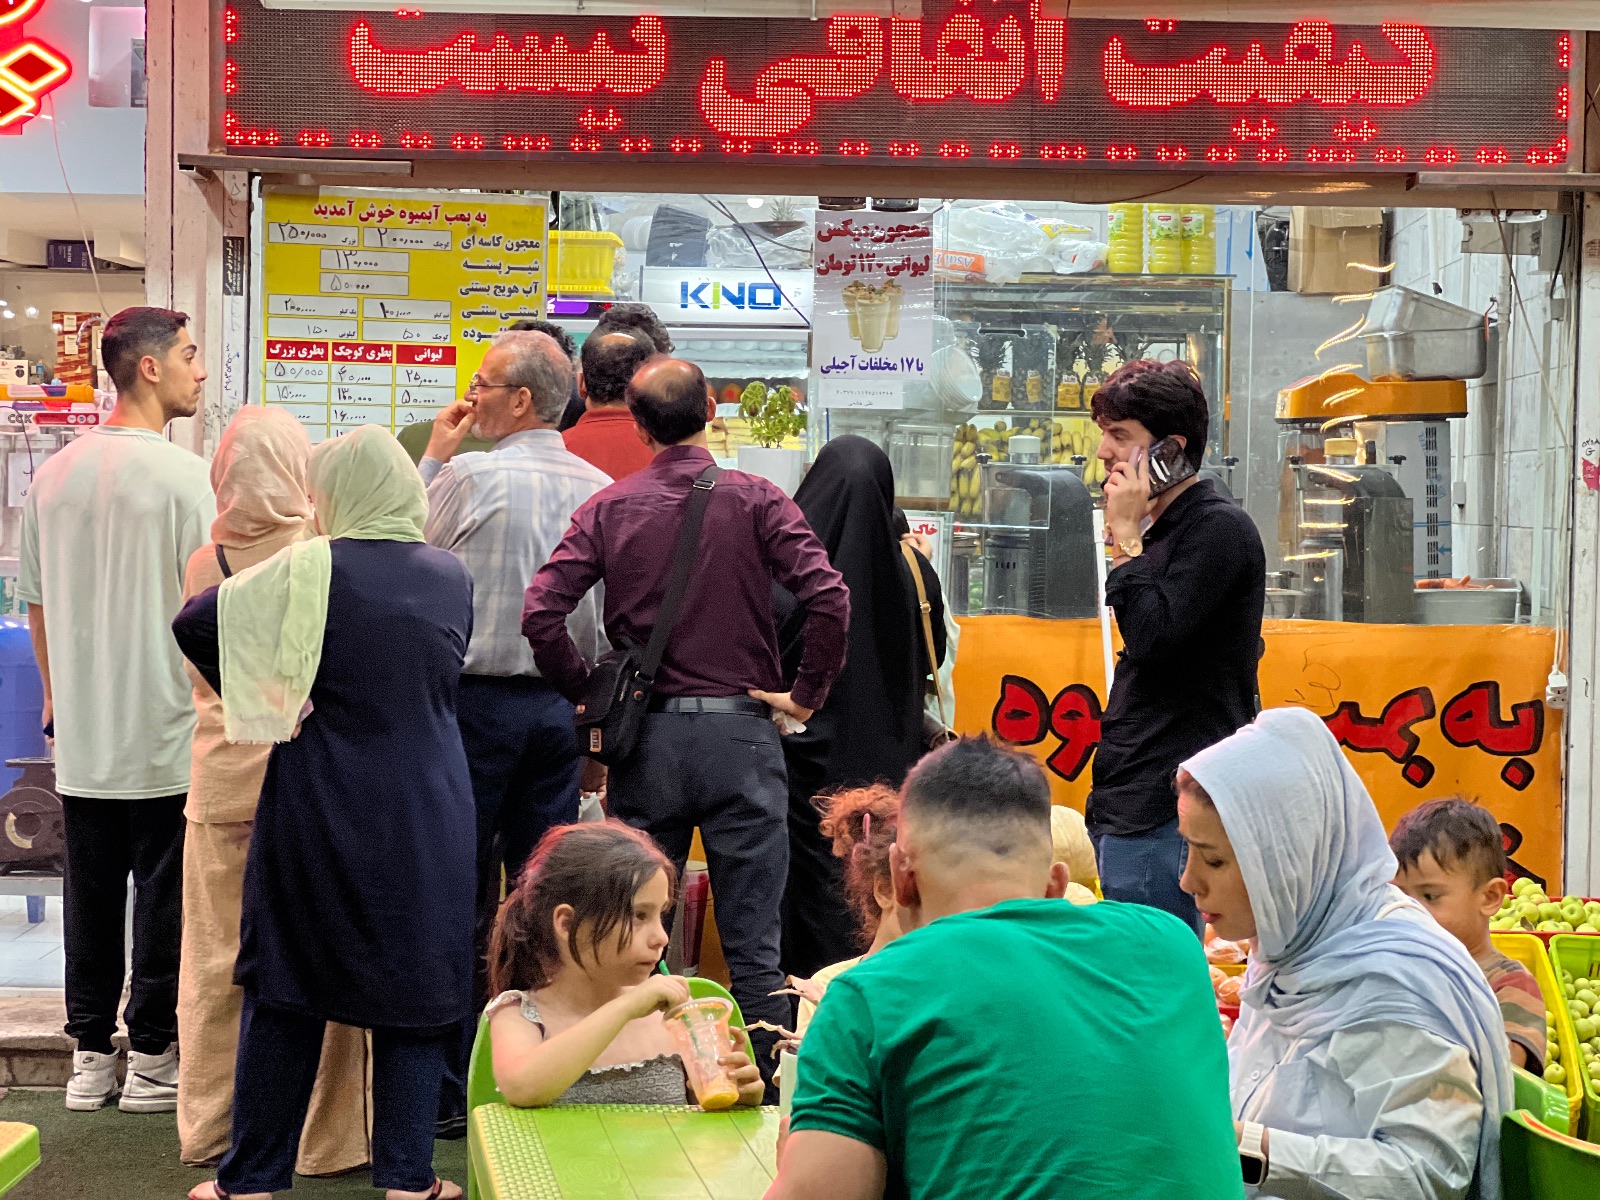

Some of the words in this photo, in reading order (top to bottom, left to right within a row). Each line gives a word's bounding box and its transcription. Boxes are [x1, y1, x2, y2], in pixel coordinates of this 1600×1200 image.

[313, 200, 355, 219] آمدید
[358, 204, 395, 223] خوش
[399, 204, 440, 224] آبمیوه
[474, 211, 487, 227] به
[461, 234, 476, 249] ای
[478, 235, 503, 247] کاسه
[505, 238, 541, 251] معجون
[462, 259, 502, 274] پسته
[505, 260, 540, 274] شیر
[817, 254, 857, 276] تومان
[459, 282, 490, 295] بستنی
[493, 284, 519, 297] هویج
[522, 281, 539, 297] آب
[461, 305, 497, 318] سنتی
[499, 306, 539, 319] بستنی
[269, 344, 297, 358] بزرگ
[297, 344, 325, 358] بطری
[333, 346, 364, 360] کوچک
[365, 346, 392, 360] بطری
[414, 348, 443, 363] لیوانی
[820, 354, 857, 374] آجیلی
[858, 356, 898, 371] مخلفات
[900, 356, 914, 372] ۱۷
[915, 357, 924, 376] با
[1440, 680, 1544, 791] به
